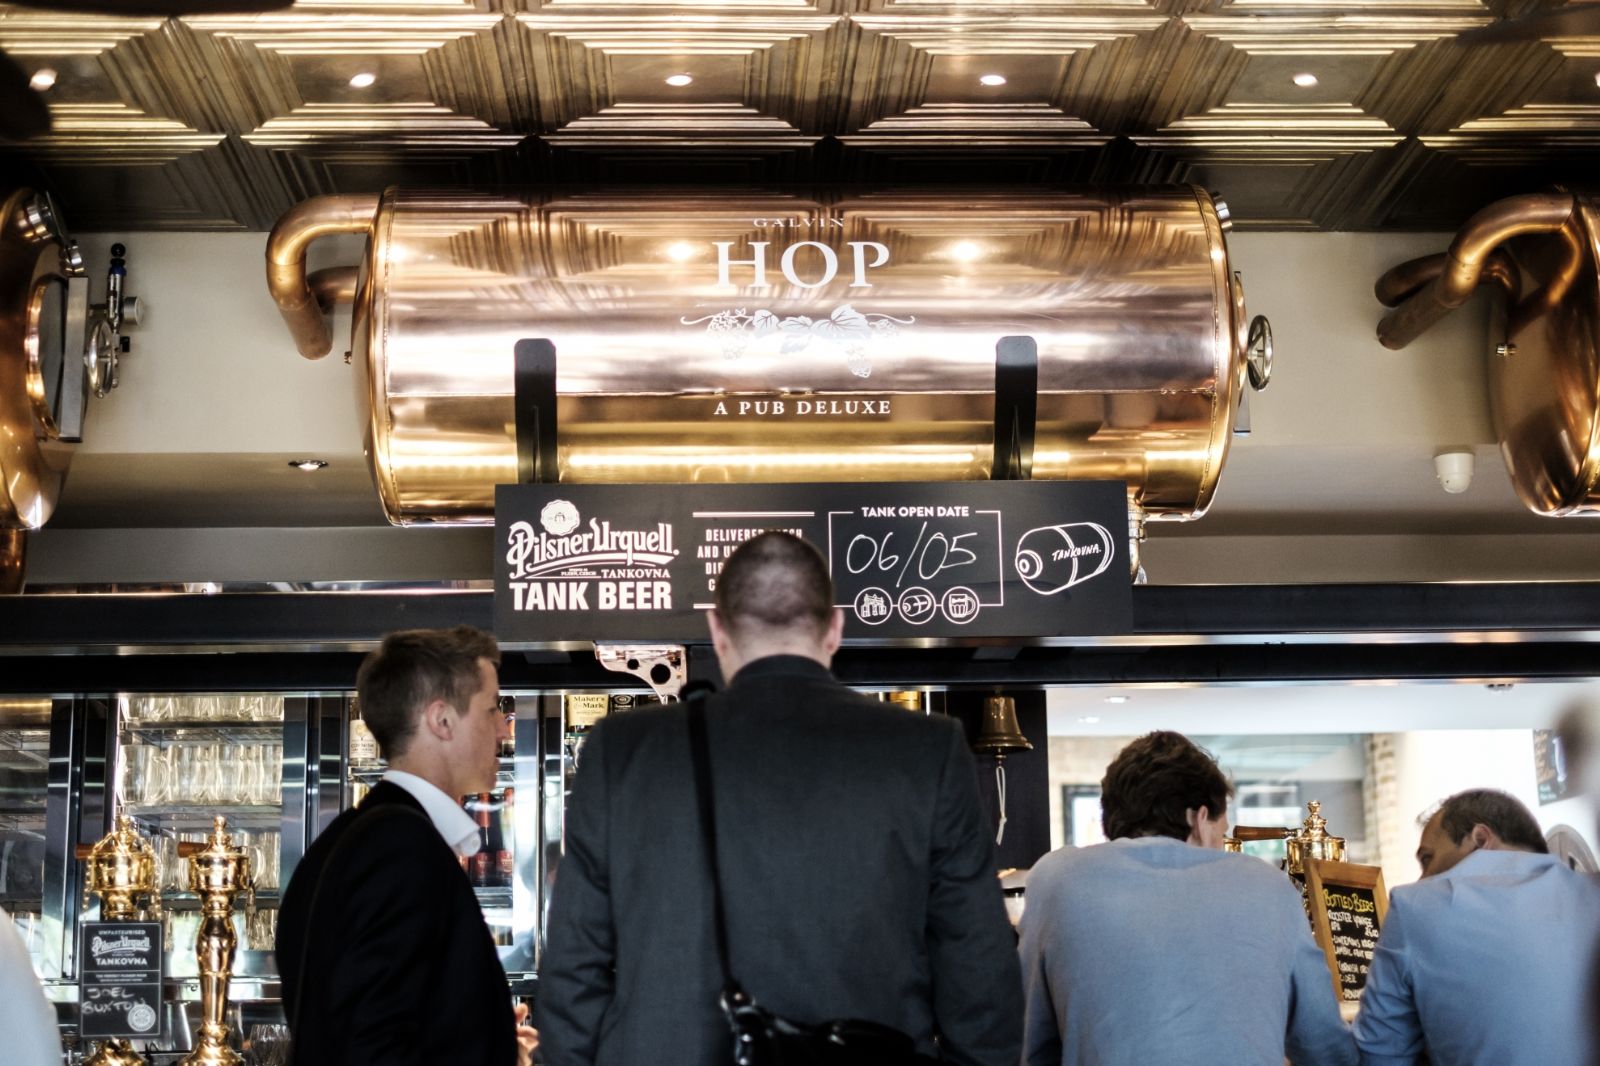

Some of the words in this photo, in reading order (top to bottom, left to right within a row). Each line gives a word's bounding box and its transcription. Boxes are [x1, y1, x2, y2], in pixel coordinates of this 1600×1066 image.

[753, 217, 844, 228] GALVIN
[712, 241, 890, 288] HOP
[714, 401, 728, 415] A
[738, 401, 785, 415] PUB
[796, 400, 891, 415] DELUXE
[861, 506, 896, 518] TANK
[898, 506, 935, 518] OPEN
[936, 506, 970, 517] DATE
[506, 520, 593, 580] Pilsner
[697, 545, 719, 559] AND
[600, 568, 671, 579] TANKOVNA
[509, 581, 590, 611] TANK
[598, 581, 672, 610] BEER
[96, 957, 148, 966] TANKOVNA
